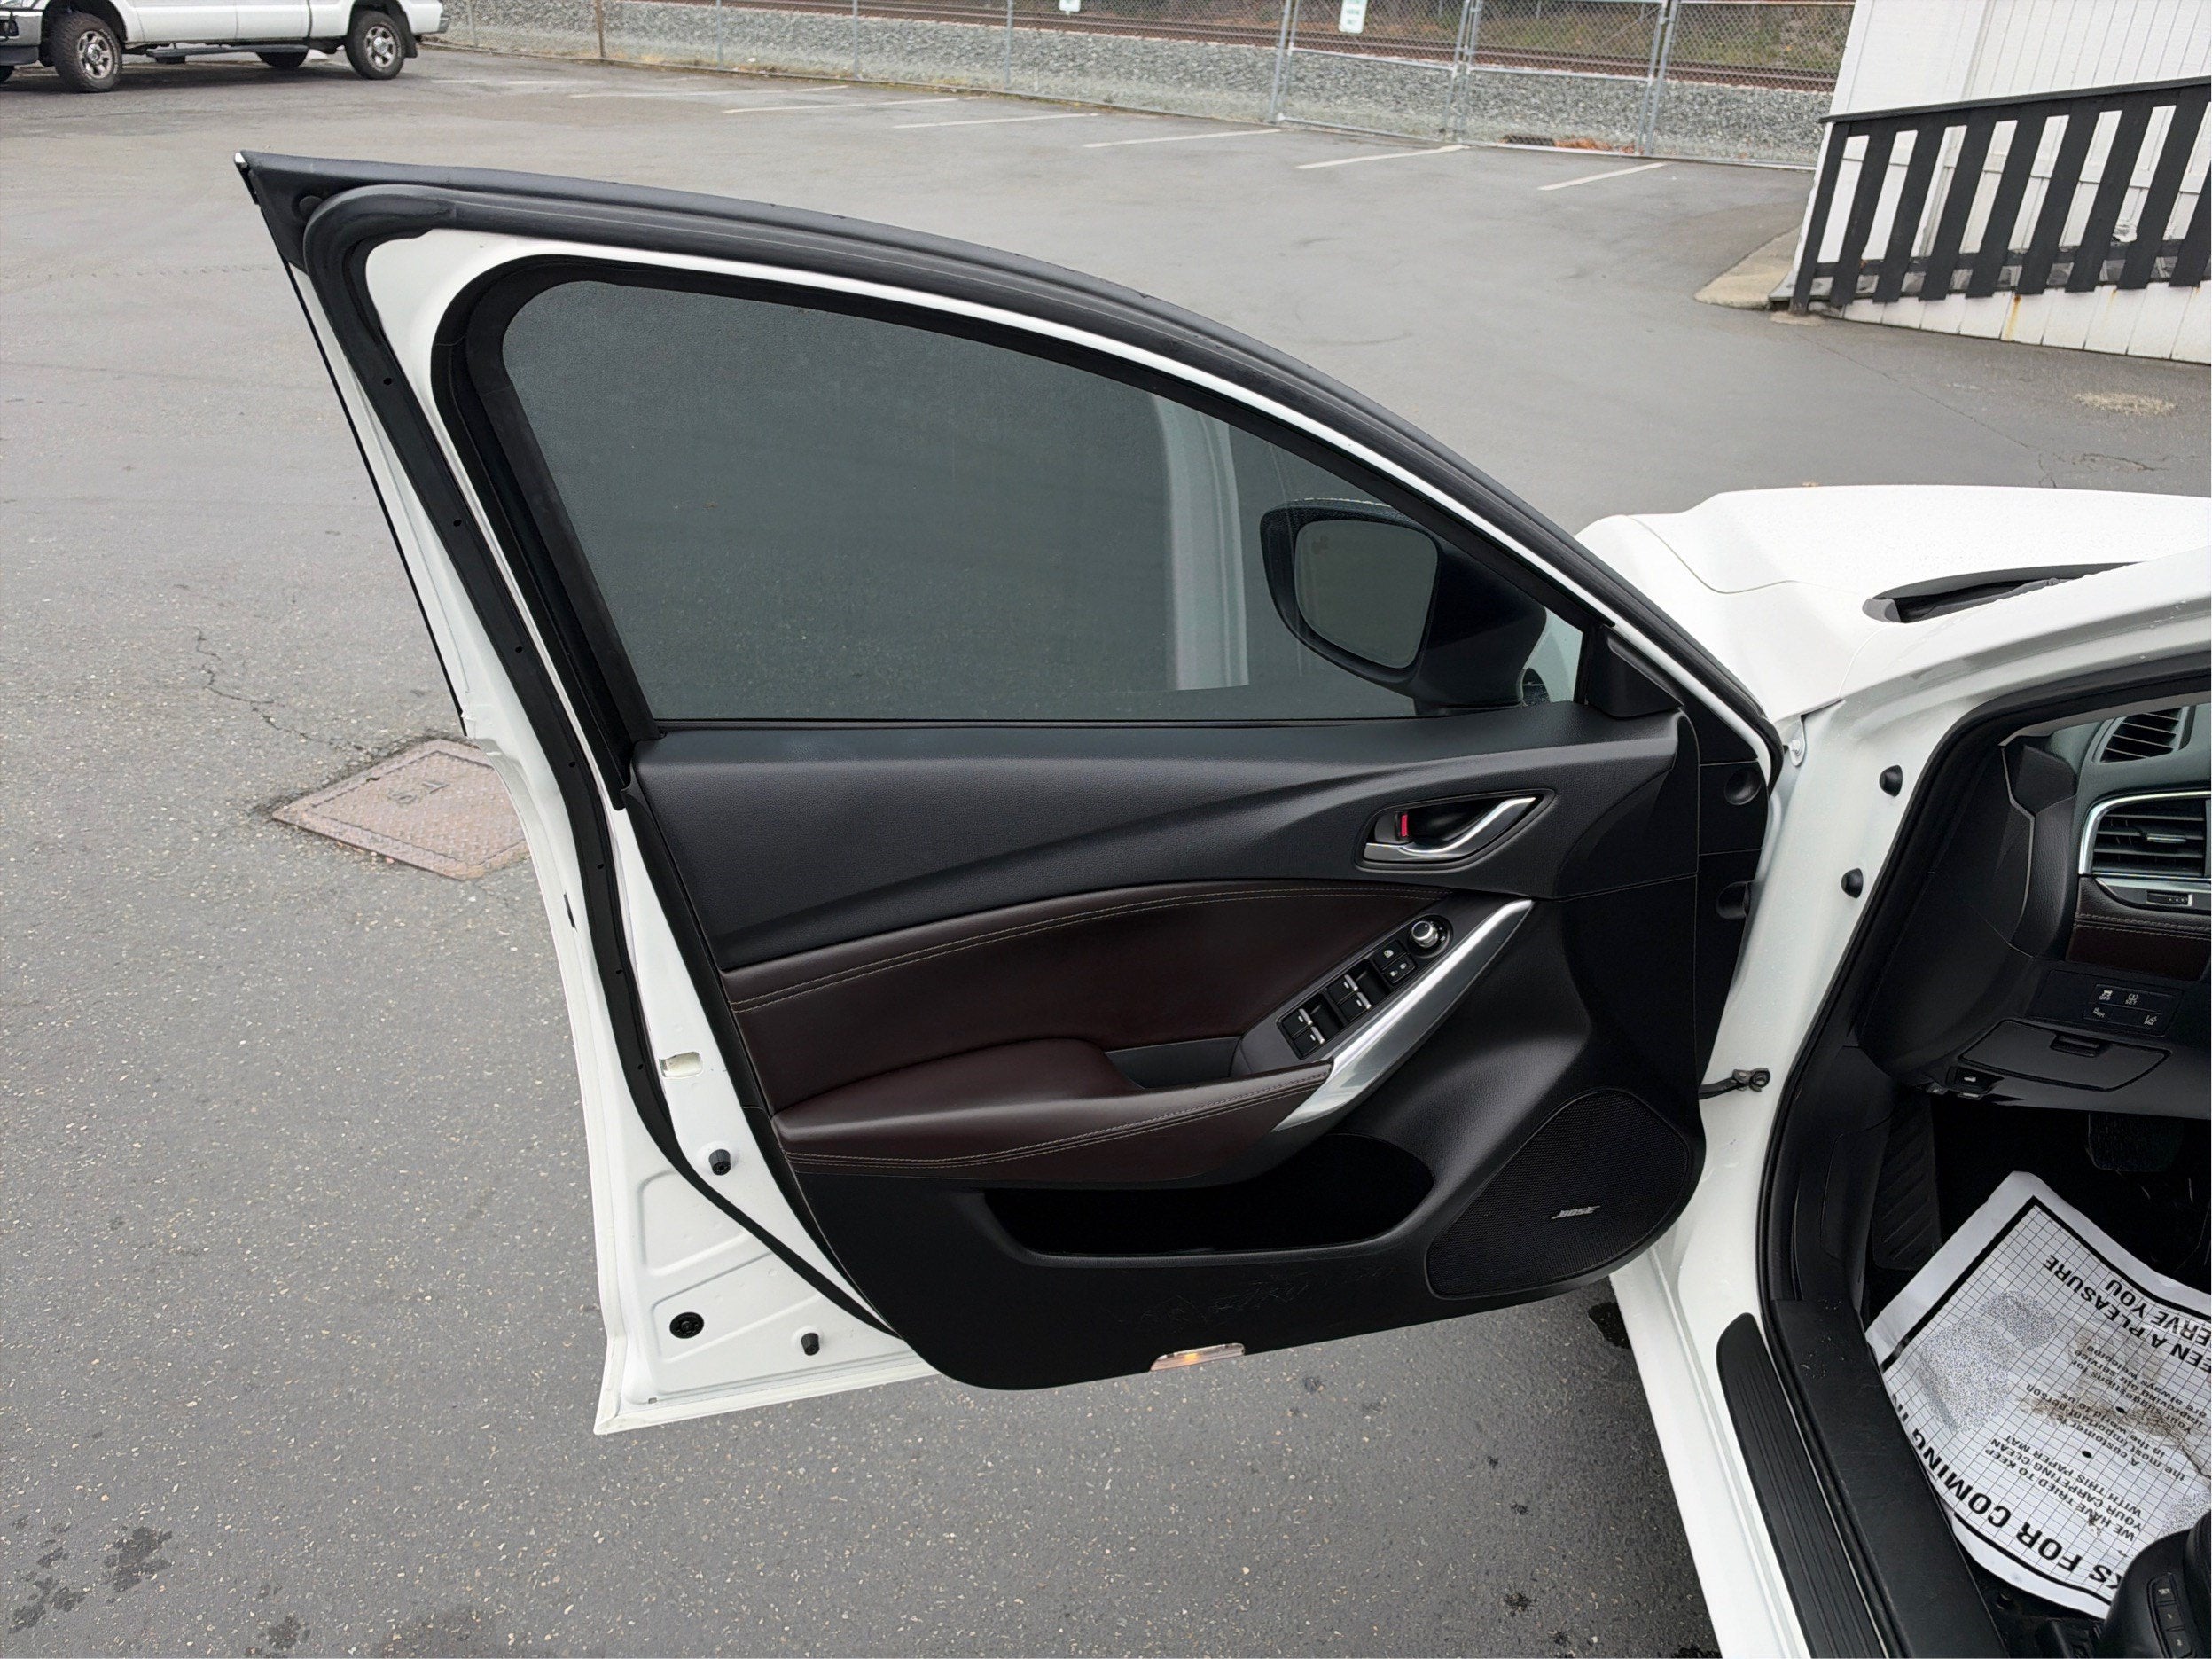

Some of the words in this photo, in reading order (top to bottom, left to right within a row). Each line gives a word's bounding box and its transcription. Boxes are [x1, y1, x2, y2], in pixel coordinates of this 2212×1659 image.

[2042, 1255, 2146, 1339] PLEASURE
[2105, 1279, 2147, 1319] YOU
[2150, 1334, 2168, 1349] A
[2072, 1359, 2088, 1374] for
[2074, 1349, 2117, 1377] service
[2090, 1371, 2162, 1416] suggestions
[2119, 1376, 2139, 1392] our
[2140, 1380, 2184, 1405] always
[2026, 1384, 2068, 1411] person
[2079, 1403, 2091, 1413] to
[2093, 1410, 2127, 1434] world
[2165, 1413, 2192, 1434] Your
[2185, 1405, 2208, 1419] are
[2067, 1408, 2128, 1447] important
[1990, 1438, 2030, 1463] CLEAN
[2005, 1435, 2031, 1452] MAT
[2070, 1422, 2128, 1459] customer
[2130, 1435, 2150, 1450] the
[1984, 1448, 2017, 1469] KEEP
[2032, 1450, 2074, 1477] PAPER
[2130, 1445, 2161, 1467] most
[2130, 1457, 2140, 1467] A
[2153, 1448, 2166, 1459] in
[1912, 1428, 2012, 1529] COMING
[2019, 1467, 2035, 1481] TO
[2033, 1461, 2104, 1507] CARPETING
[2075, 1474, 2105, 1496] THIS
[2165, 1467, 2185, 1481] the
[2037, 1478, 2074, 1506] TRIED
[2075, 1502, 2112, 1528] HAVE
[2107, 1492, 2141, 1517] WITH
[2106, 1506, 2141, 1531] YOUR
[2113, 1525, 2135, 1542] WE
[2016, 1522, 2083, 1572] FOR
